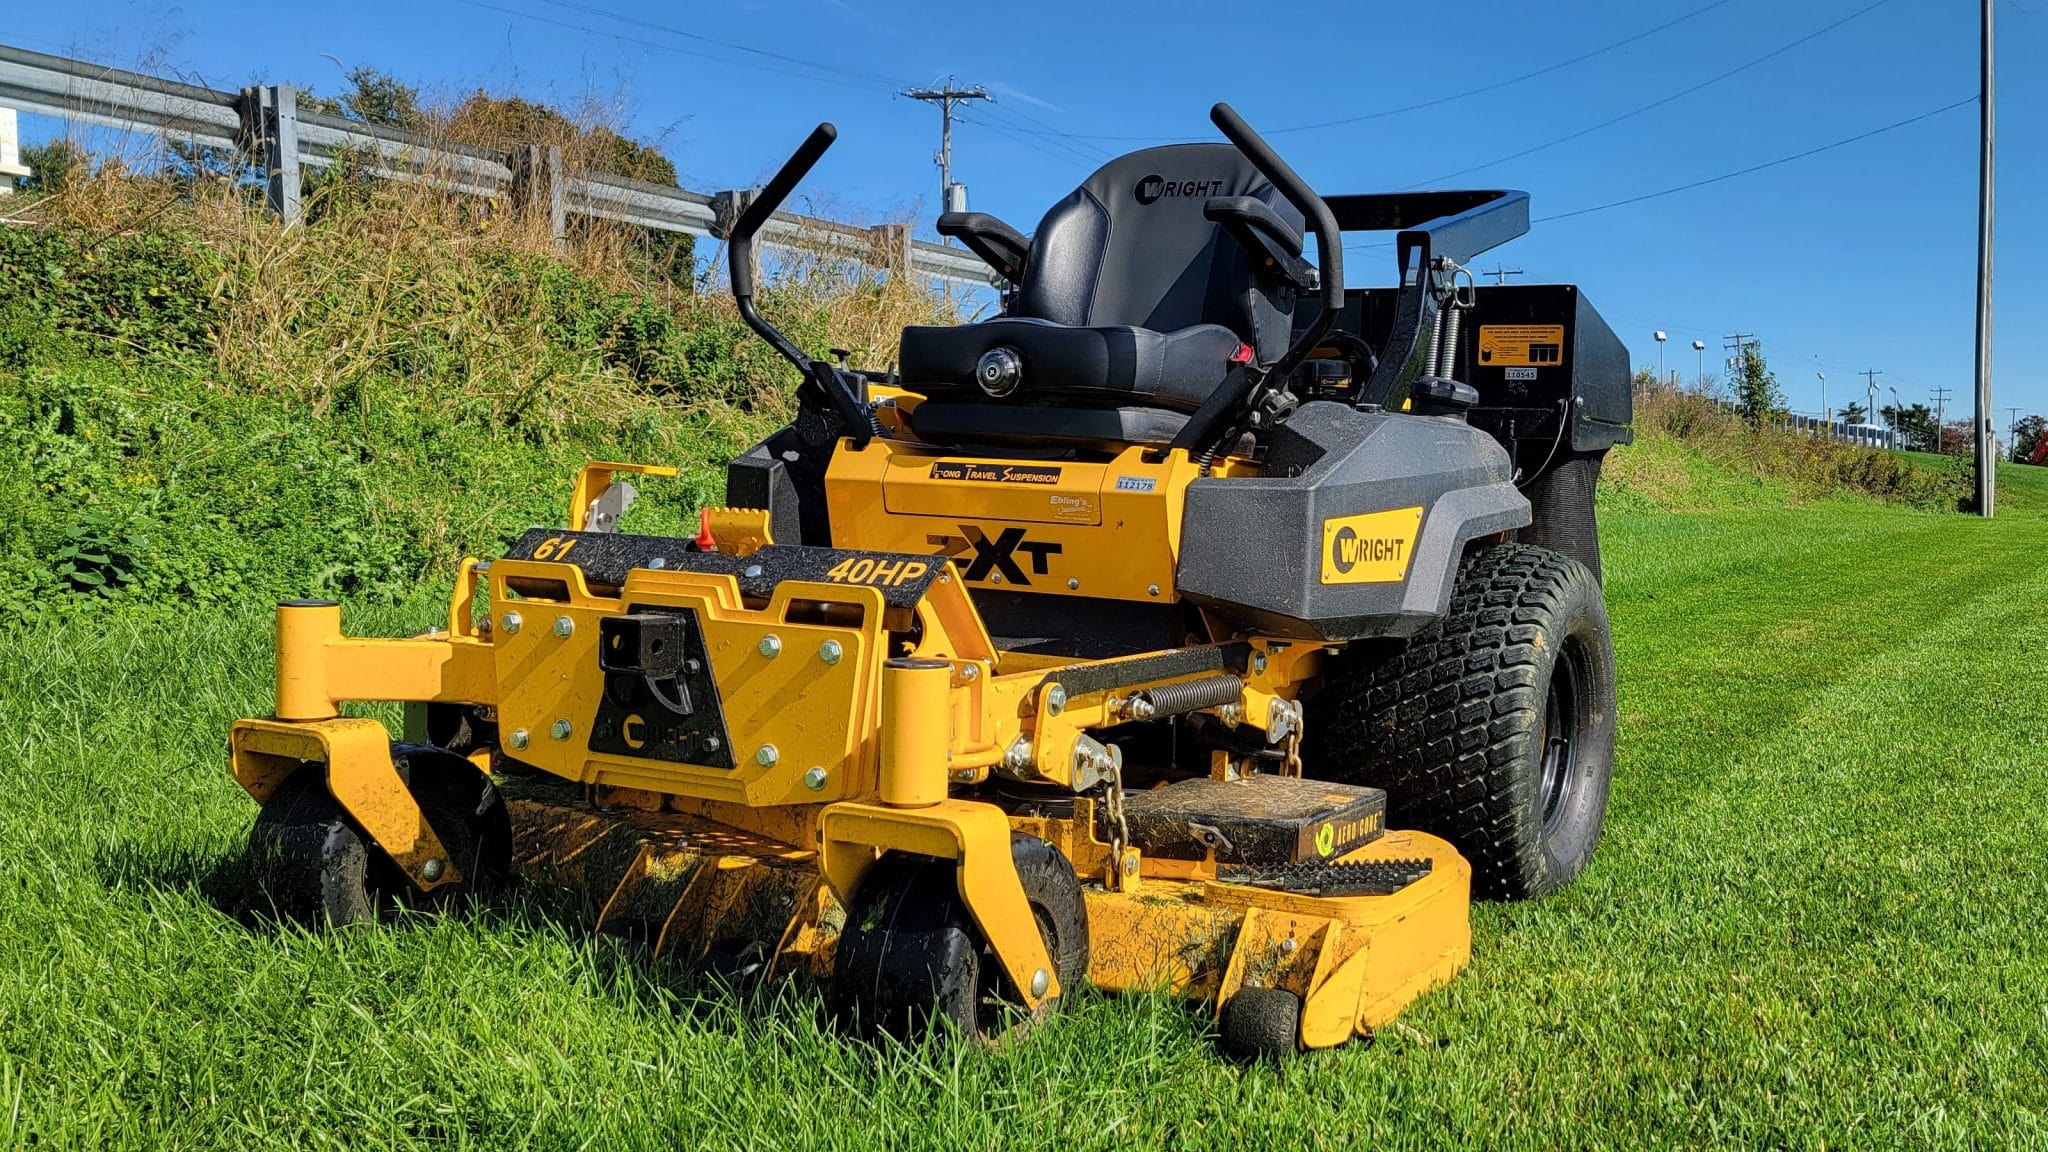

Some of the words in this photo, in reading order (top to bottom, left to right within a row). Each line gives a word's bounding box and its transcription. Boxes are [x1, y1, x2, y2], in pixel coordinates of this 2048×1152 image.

[1143, 179, 1223, 198] WRIGHT
[1507, 371, 1535, 379] 110545
[933, 463, 961, 479] LONG
[965, 464, 998, 480] TRAVEL
[1000, 467, 1059, 483] SUSPENSION
[1118, 480, 1153, 491] 112178
[1050, 495, 1087, 507] Ebling's
[533, 537, 577, 561] 61
[1338, 536, 1405, 564] WRIGHT
[827, 558, 928, 586] 40HP
[1336, 822, 1357, 846] AERO
